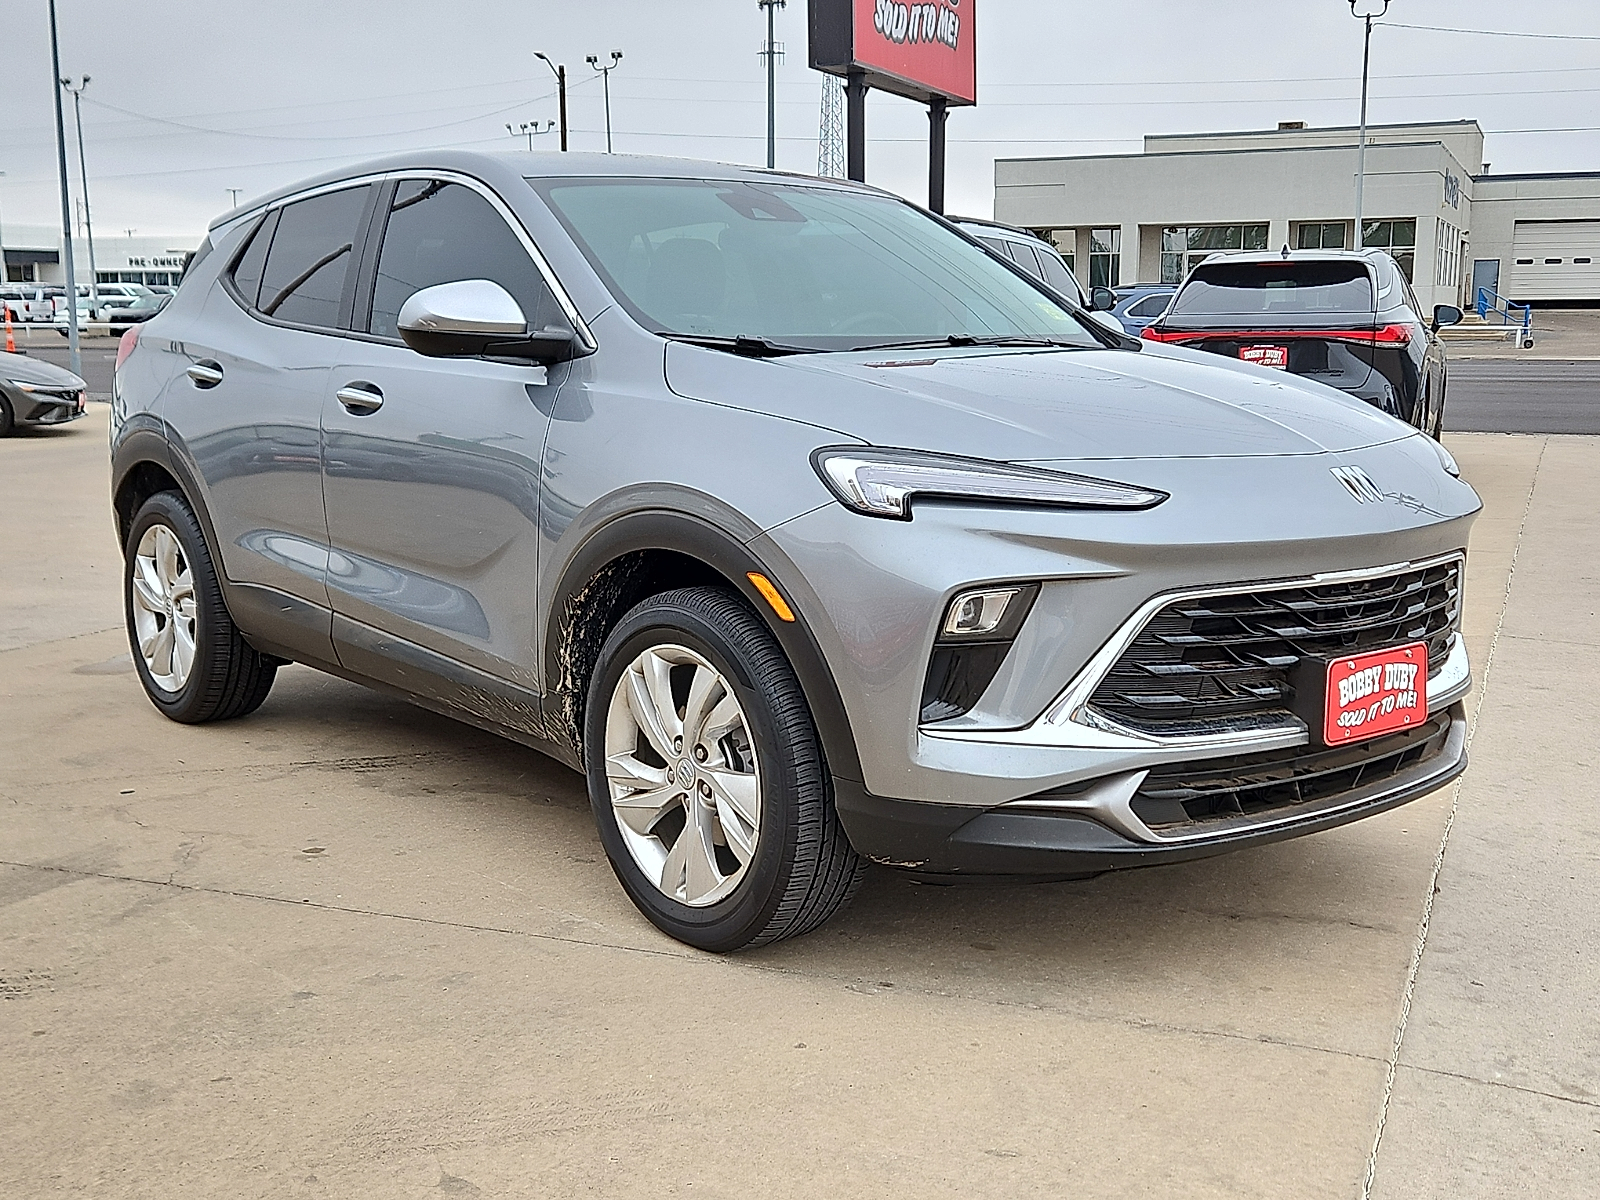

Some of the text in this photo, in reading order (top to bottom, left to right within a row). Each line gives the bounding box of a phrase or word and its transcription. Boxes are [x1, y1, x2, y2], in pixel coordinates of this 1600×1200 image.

[874, 0, 960, 50] SOLD IT TO ME!
[1338, 662, 1419, 708] BOBBY DUBY
[1337, 690, 1418, 727] SOLD IT TO ME!
